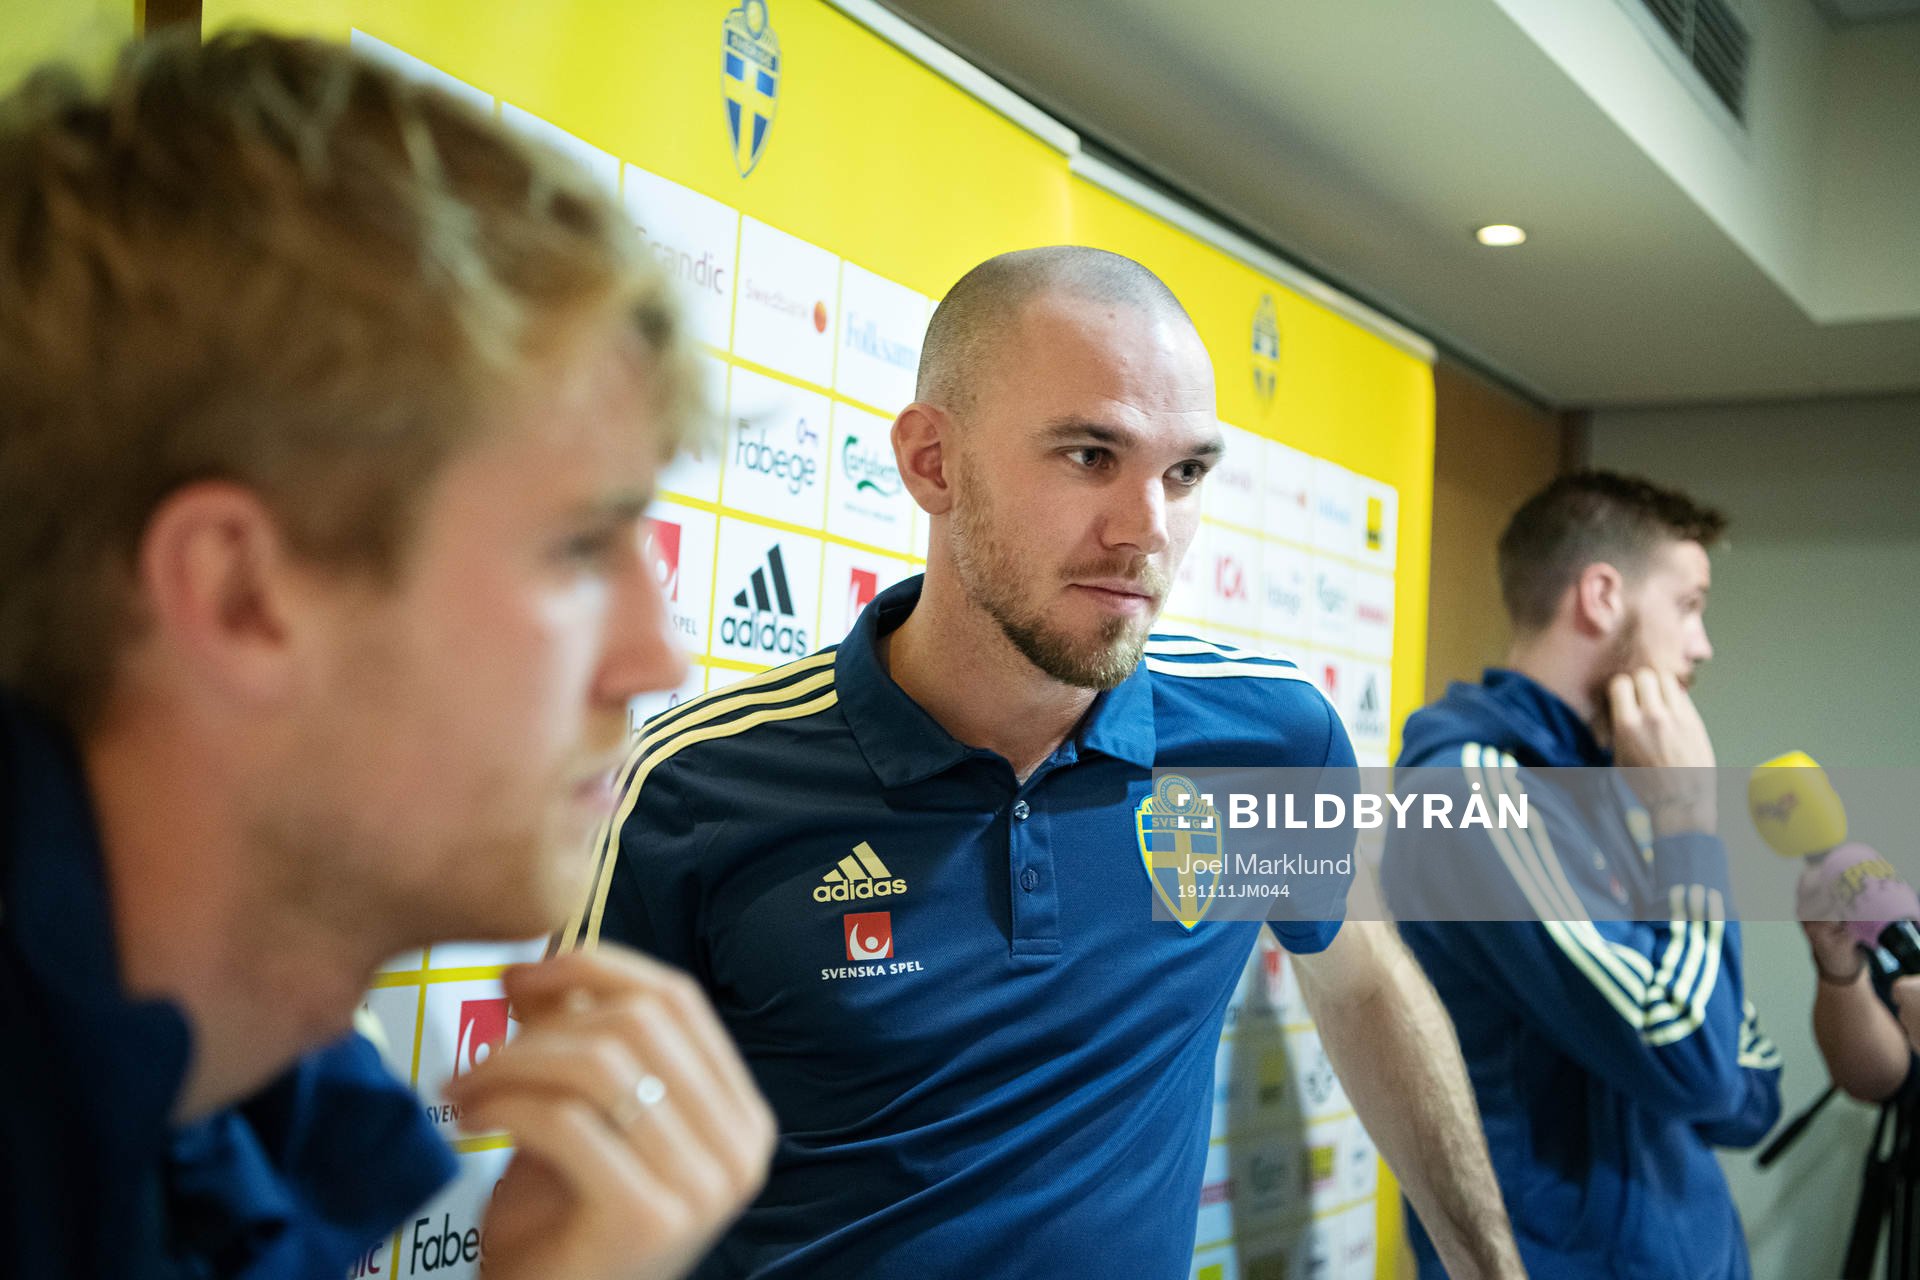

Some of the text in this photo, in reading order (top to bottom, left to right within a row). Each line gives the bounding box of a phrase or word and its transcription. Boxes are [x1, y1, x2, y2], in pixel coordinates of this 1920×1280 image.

[737, 418, 815, 494] Fabege
[721, 612, 806, 656] adidas
[813, 878, 907, 902] adidas
[821, 961, 924, 980] SVENSKA SPEL
[427, 1104, 463, 1124] SVEN
[411, 1213, 480, 1275] Fabe
